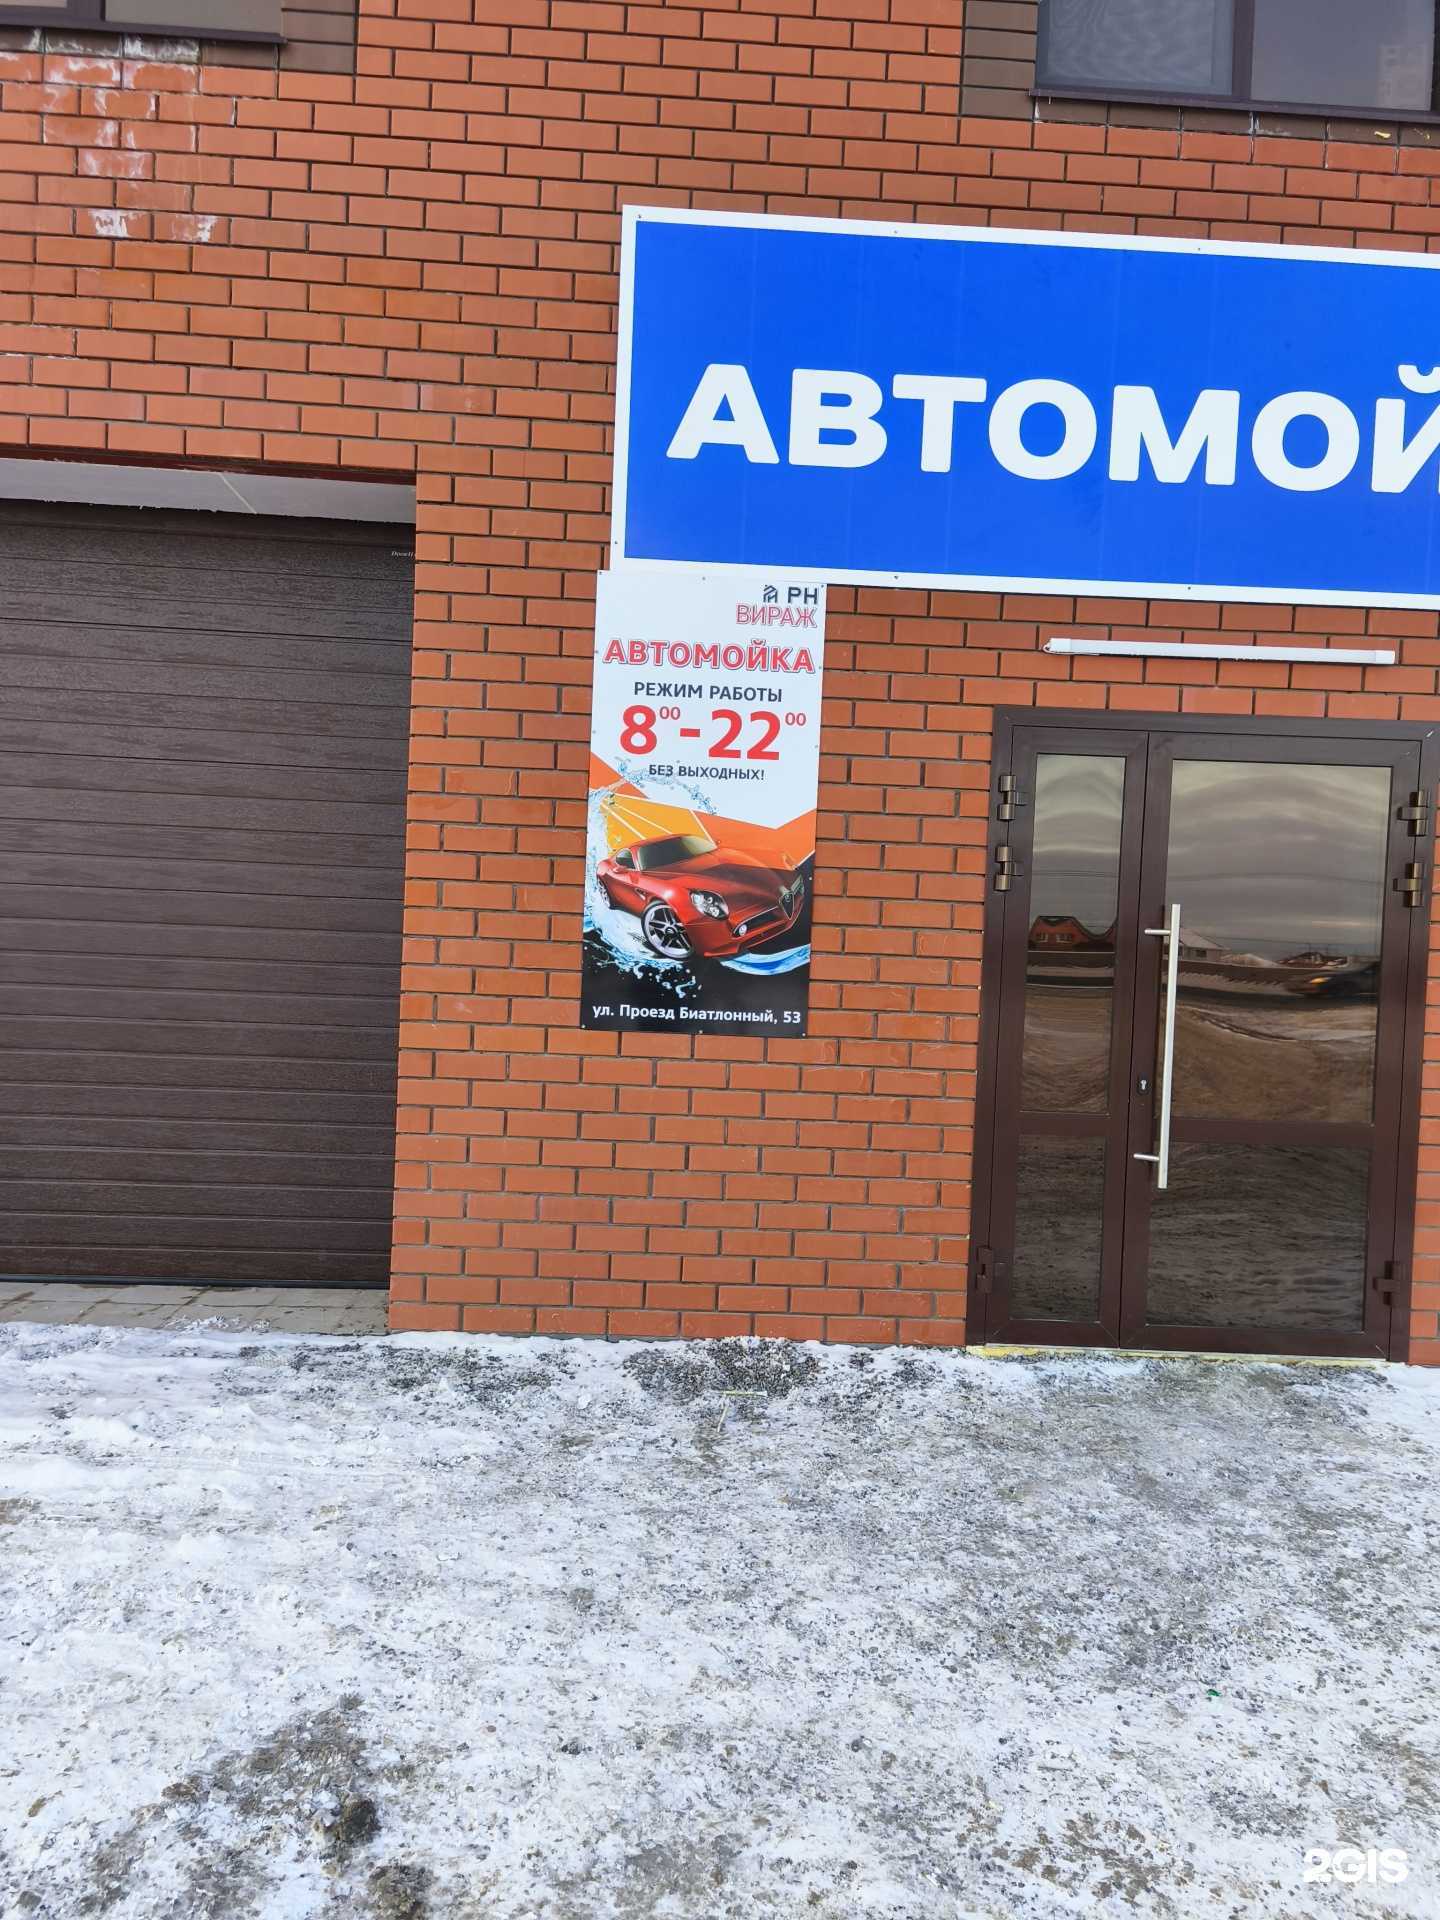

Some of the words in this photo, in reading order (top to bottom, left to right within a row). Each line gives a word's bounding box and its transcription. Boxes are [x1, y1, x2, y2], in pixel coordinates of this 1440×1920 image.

[736, 604, 818, 628] ВИРАЖ
[602, 638, 814, 673] АВТОМОЙКА
[633, 681, 703, 699] РЕЖИМ
[709, 685, 782, 702] РАБОТЫ
[648, 764, 674, 777] БЕЗ
[677, 766, 765, 781] ВЫХОДНЫХ!
[592, 1005, 614, 1017] ул.
[619, 1004, 675, 1020] Проезд
[679, 1007, 778, 1023] Биатлонный,
[783, 1011, 801, 1023] 53
